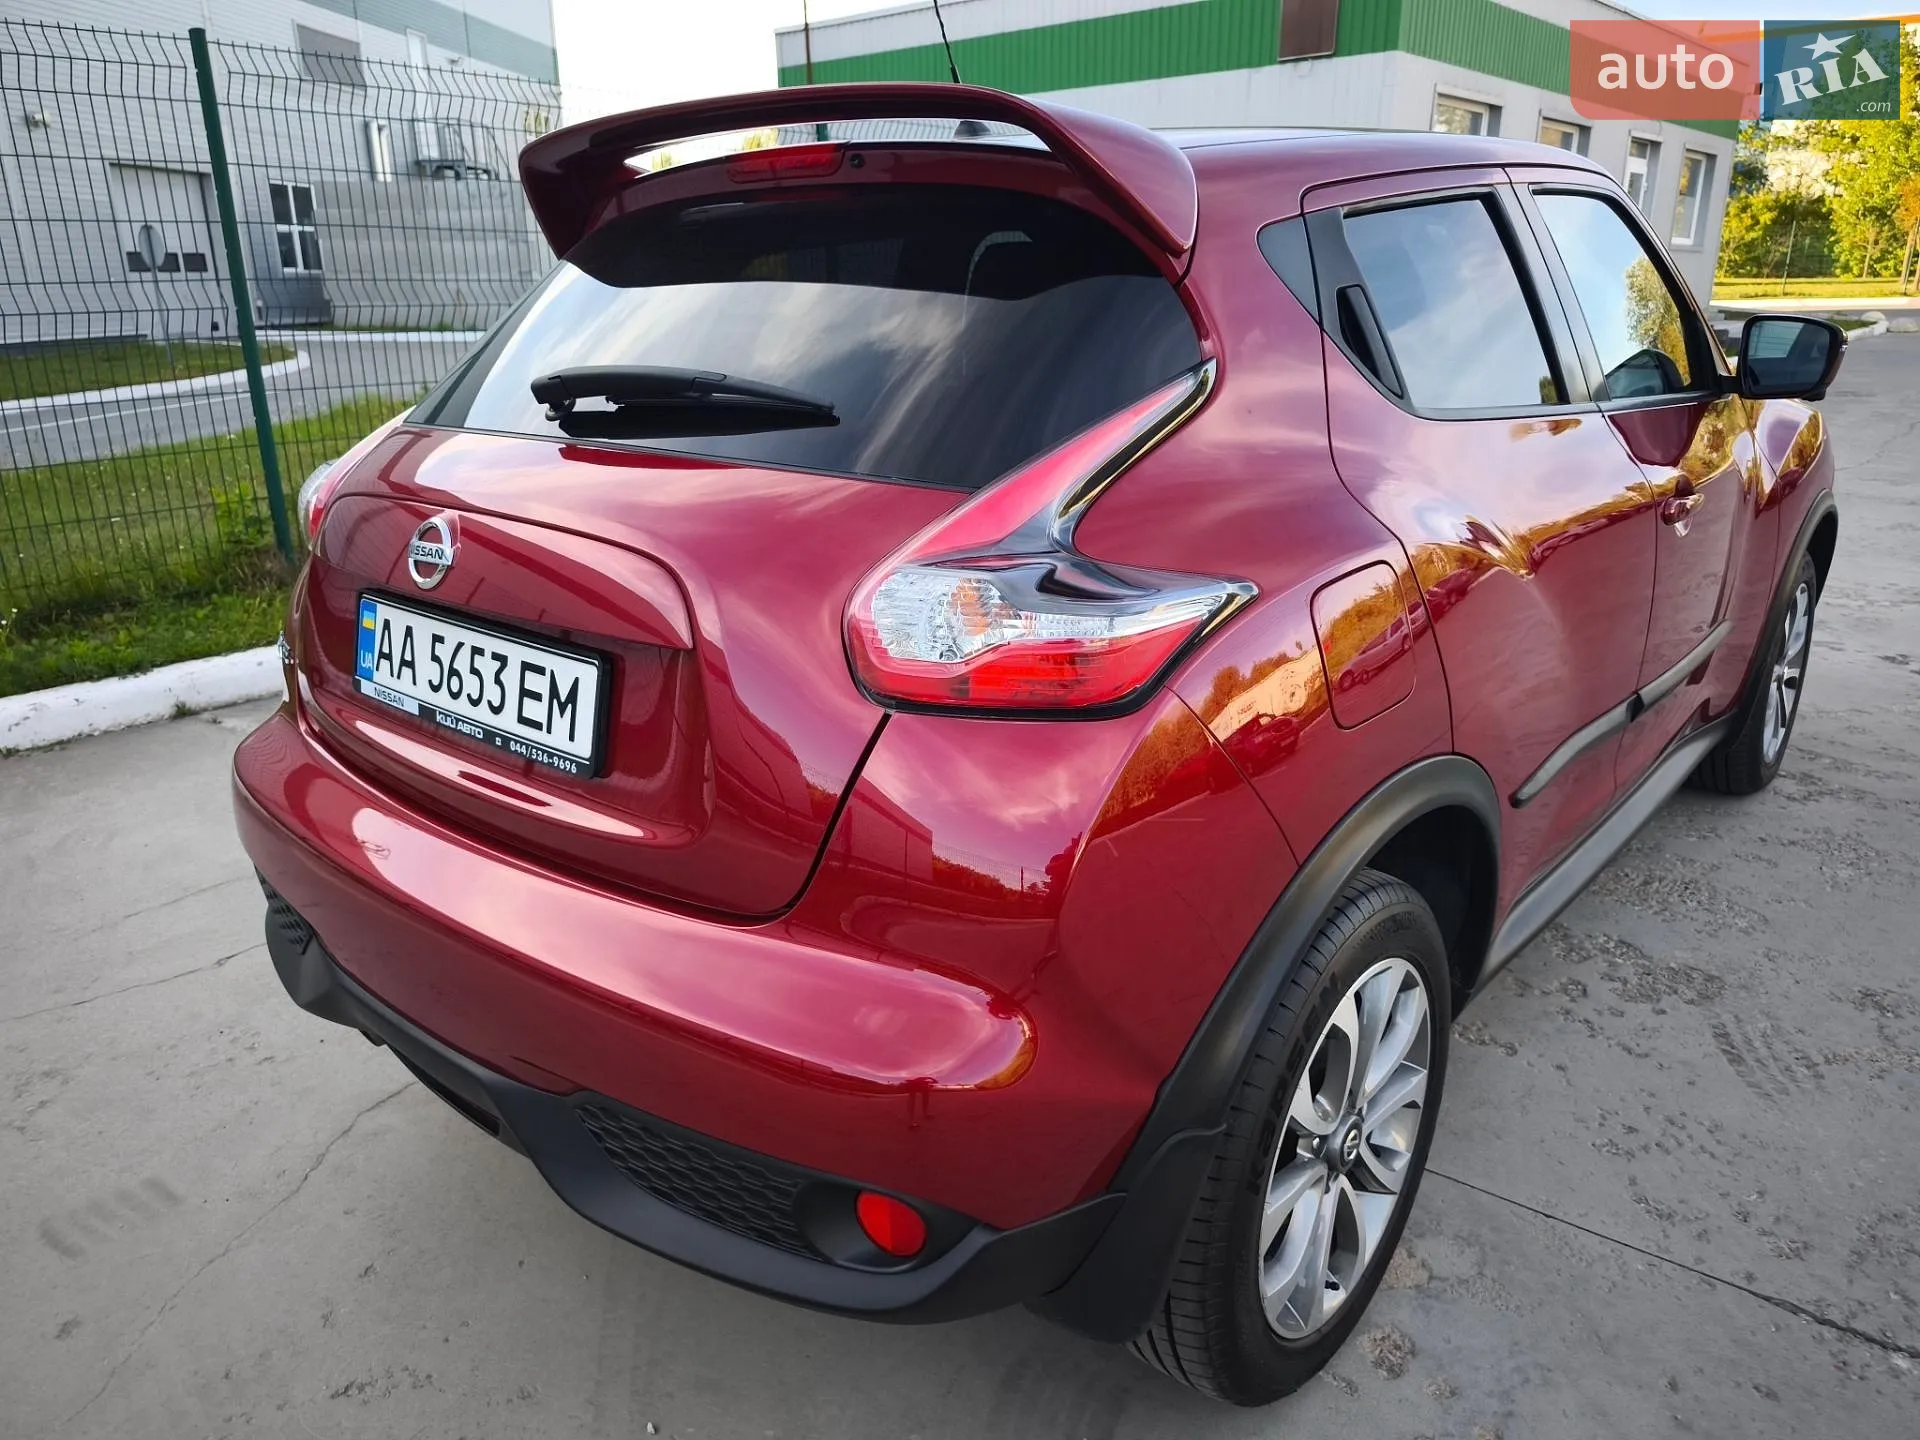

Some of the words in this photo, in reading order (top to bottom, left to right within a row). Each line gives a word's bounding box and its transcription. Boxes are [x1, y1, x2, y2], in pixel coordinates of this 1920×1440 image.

[360, 649, 373, 670] UA
[375, 617, 417, 687] AA
[427, 632, 509, 716] 5653
[516, 660, 580, 743] EM
[374, 686, 405, 707] NISSAN
[509, 740, 577, 774] 044/536-9696
